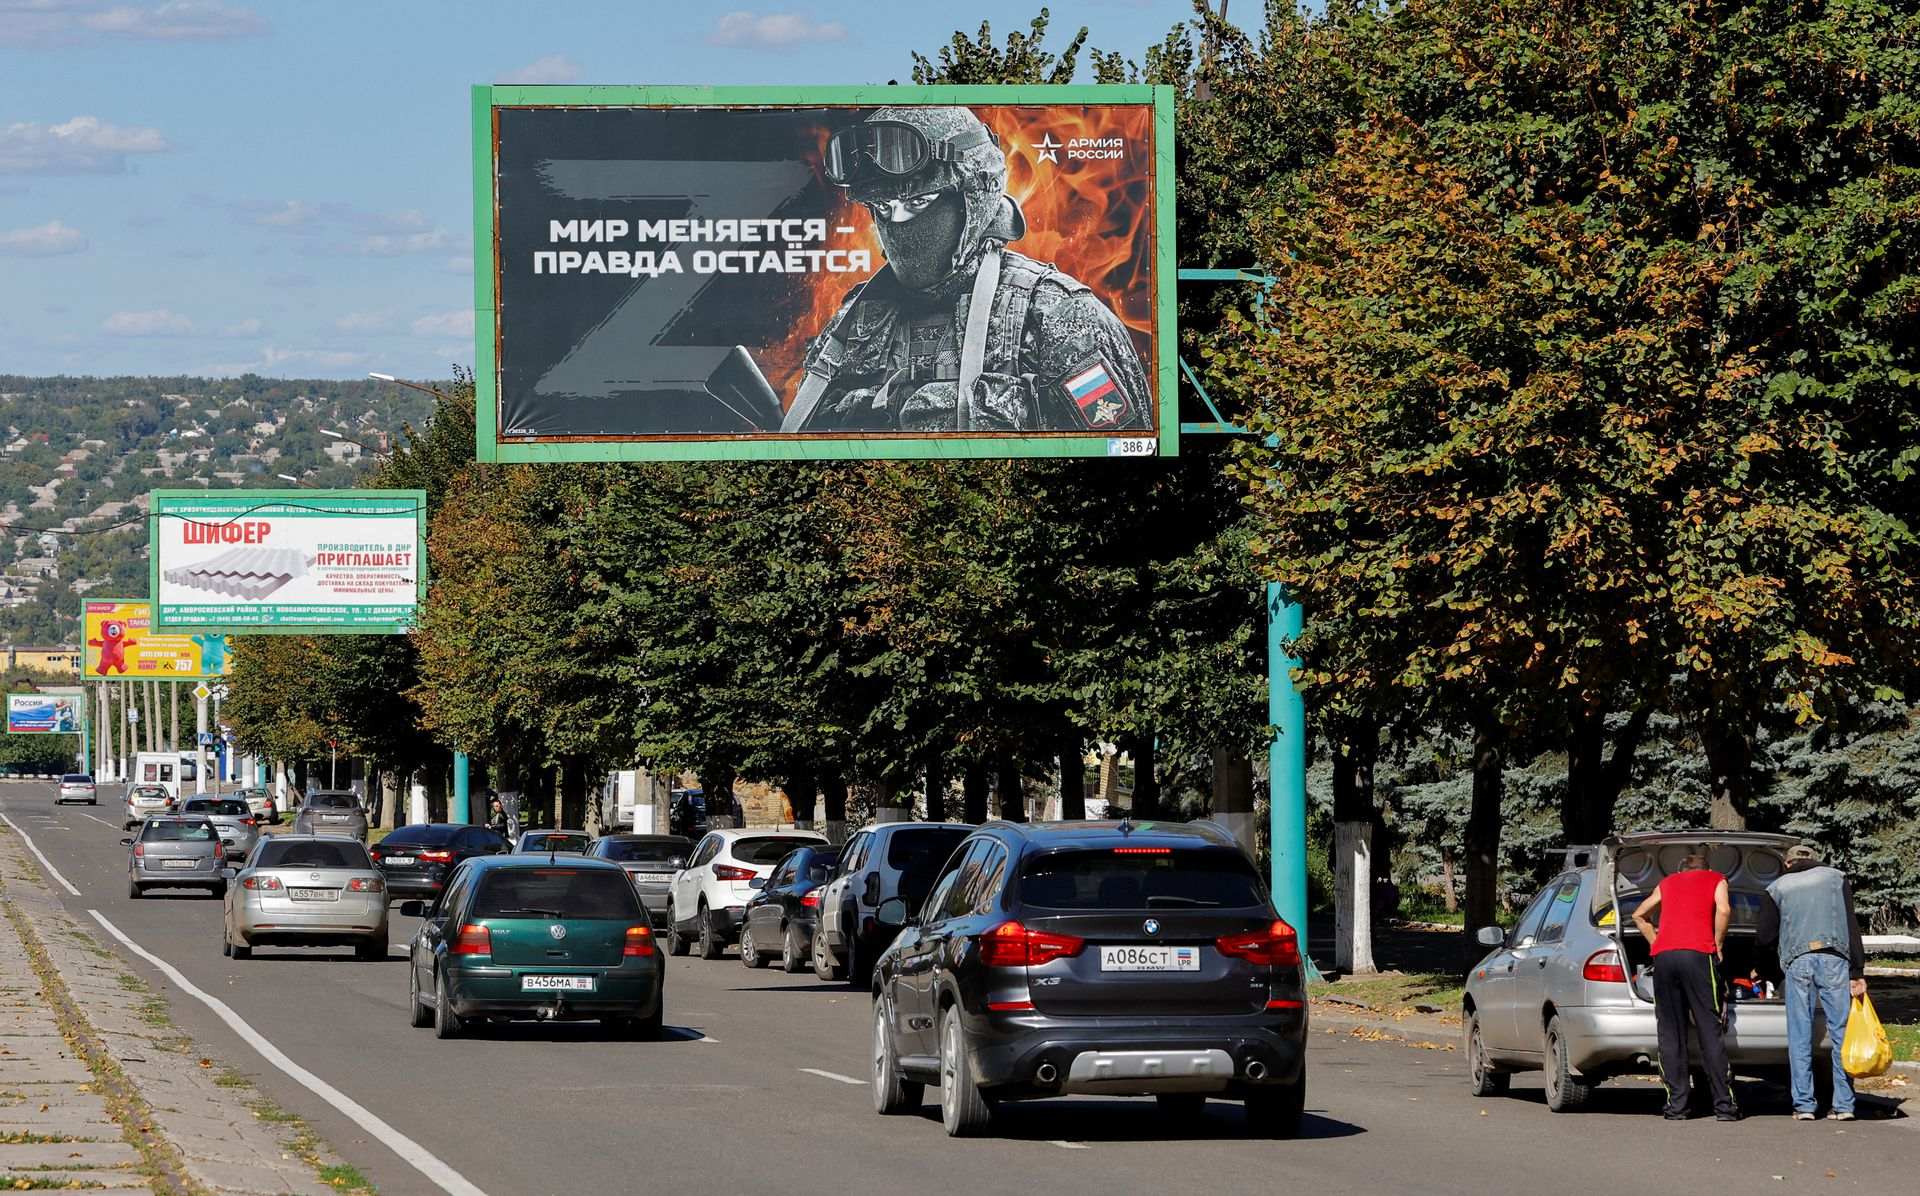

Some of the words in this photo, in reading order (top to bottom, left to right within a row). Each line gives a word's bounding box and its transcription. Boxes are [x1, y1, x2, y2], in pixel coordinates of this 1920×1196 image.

[1068, 138, 1124, 149] АРМИЯ
[1068, 150, 1124, 160] РОССИИ
[550, 219, 629, 243] МИР
[638, 218, 826, 243] МЕНЯЕТСЯ
[534, 250, 684, 278] ПРАВДА
[692, 242, 871, 273] ОСТАЁТСЯ
[1122, 441, 1144, 453] 386
[183, 522, 271, 544] ШИФЕР
[317, 543, 385, 552] ПРОИЗВОДИТЕЛЬ
[387, 543, 393, 551] В
[395, 543, 412, 552] ДНР
[317, 553, 412, 566] ПРИГЛАШАЕТ
[1106, 949, 1168, 965] А086СТ
[527, 977, 571, 988] В456МА
